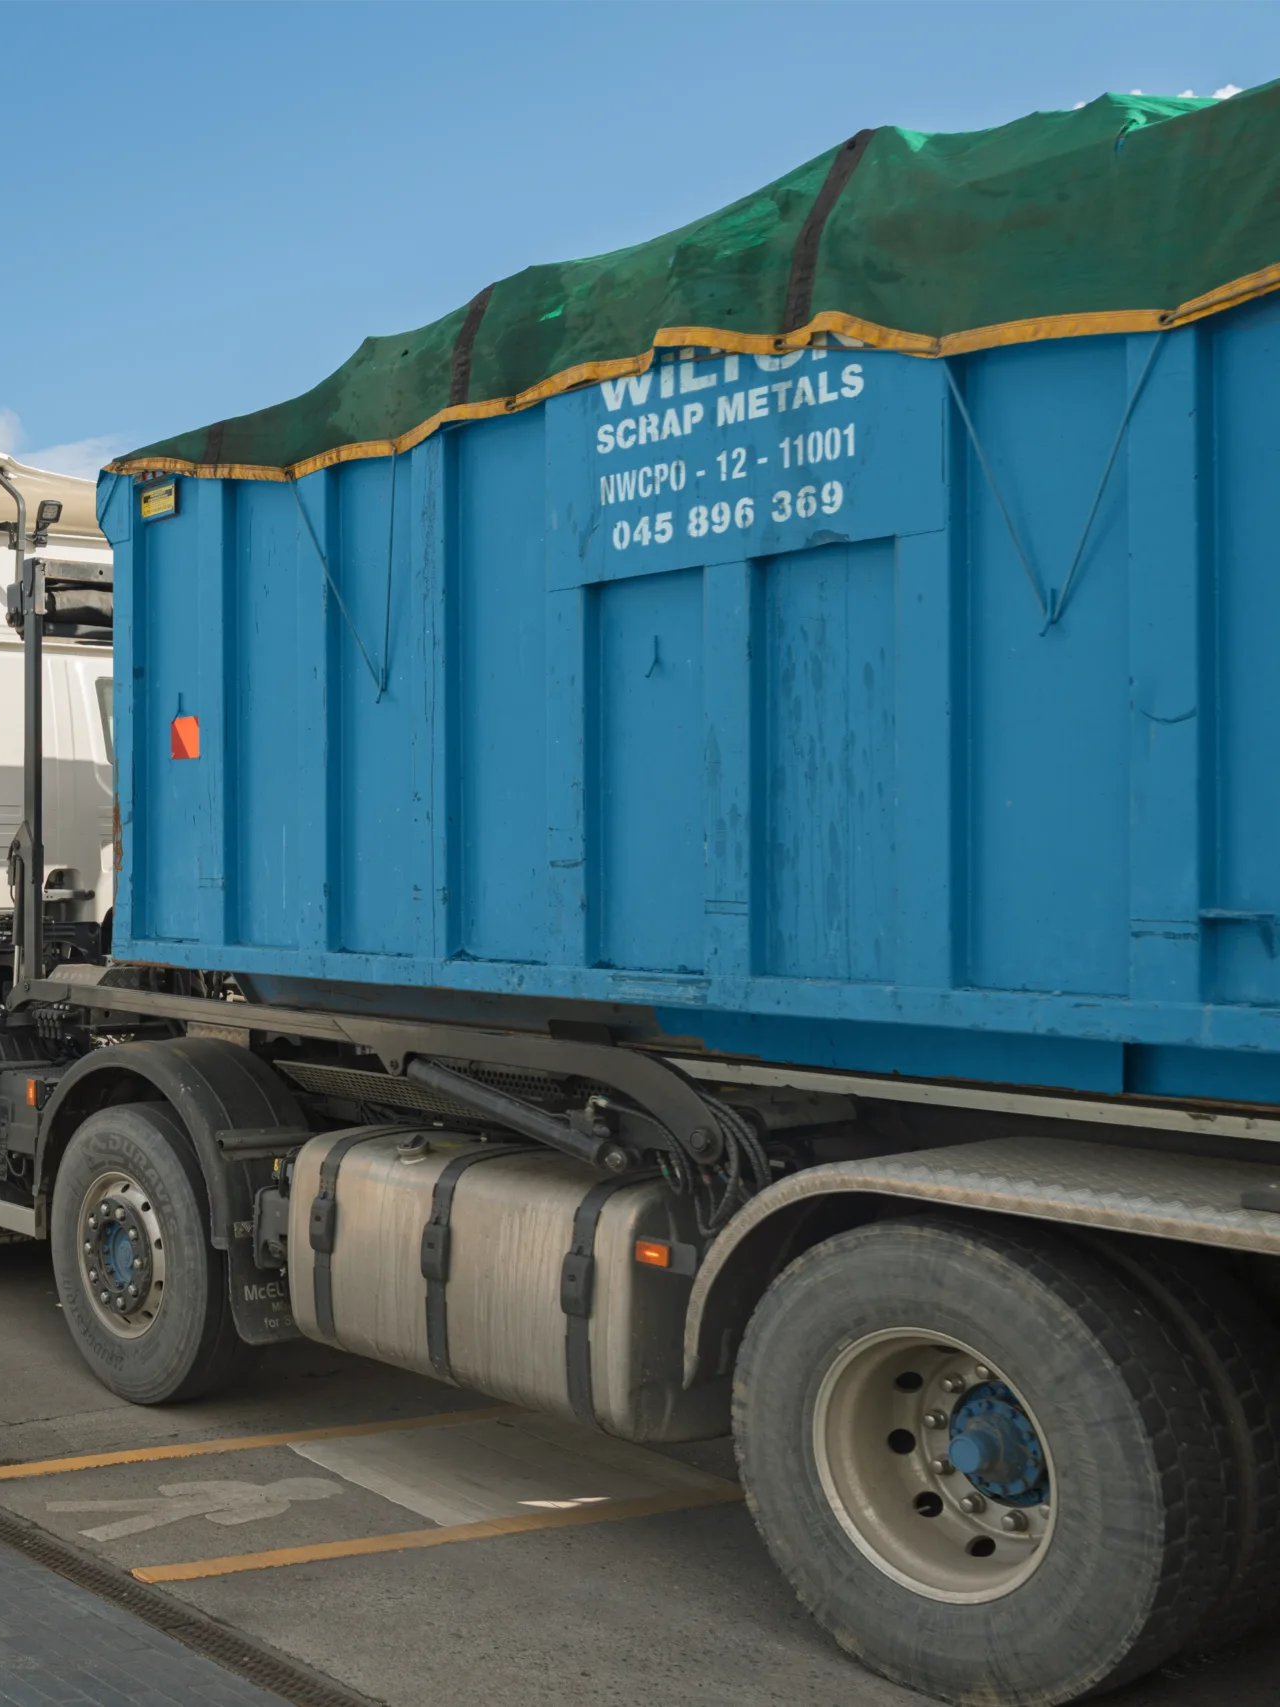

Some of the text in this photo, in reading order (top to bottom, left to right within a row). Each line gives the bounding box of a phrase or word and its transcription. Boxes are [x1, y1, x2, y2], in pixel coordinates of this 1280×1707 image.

[596, 364, 864, 454] SCRAP METALS
[716, 446, 747, 482] 12
[779, 422, 855, 469] 11001
[612, 480, 844, 551] 045 896 369
[243, 1281, 286, 1302] McEL
